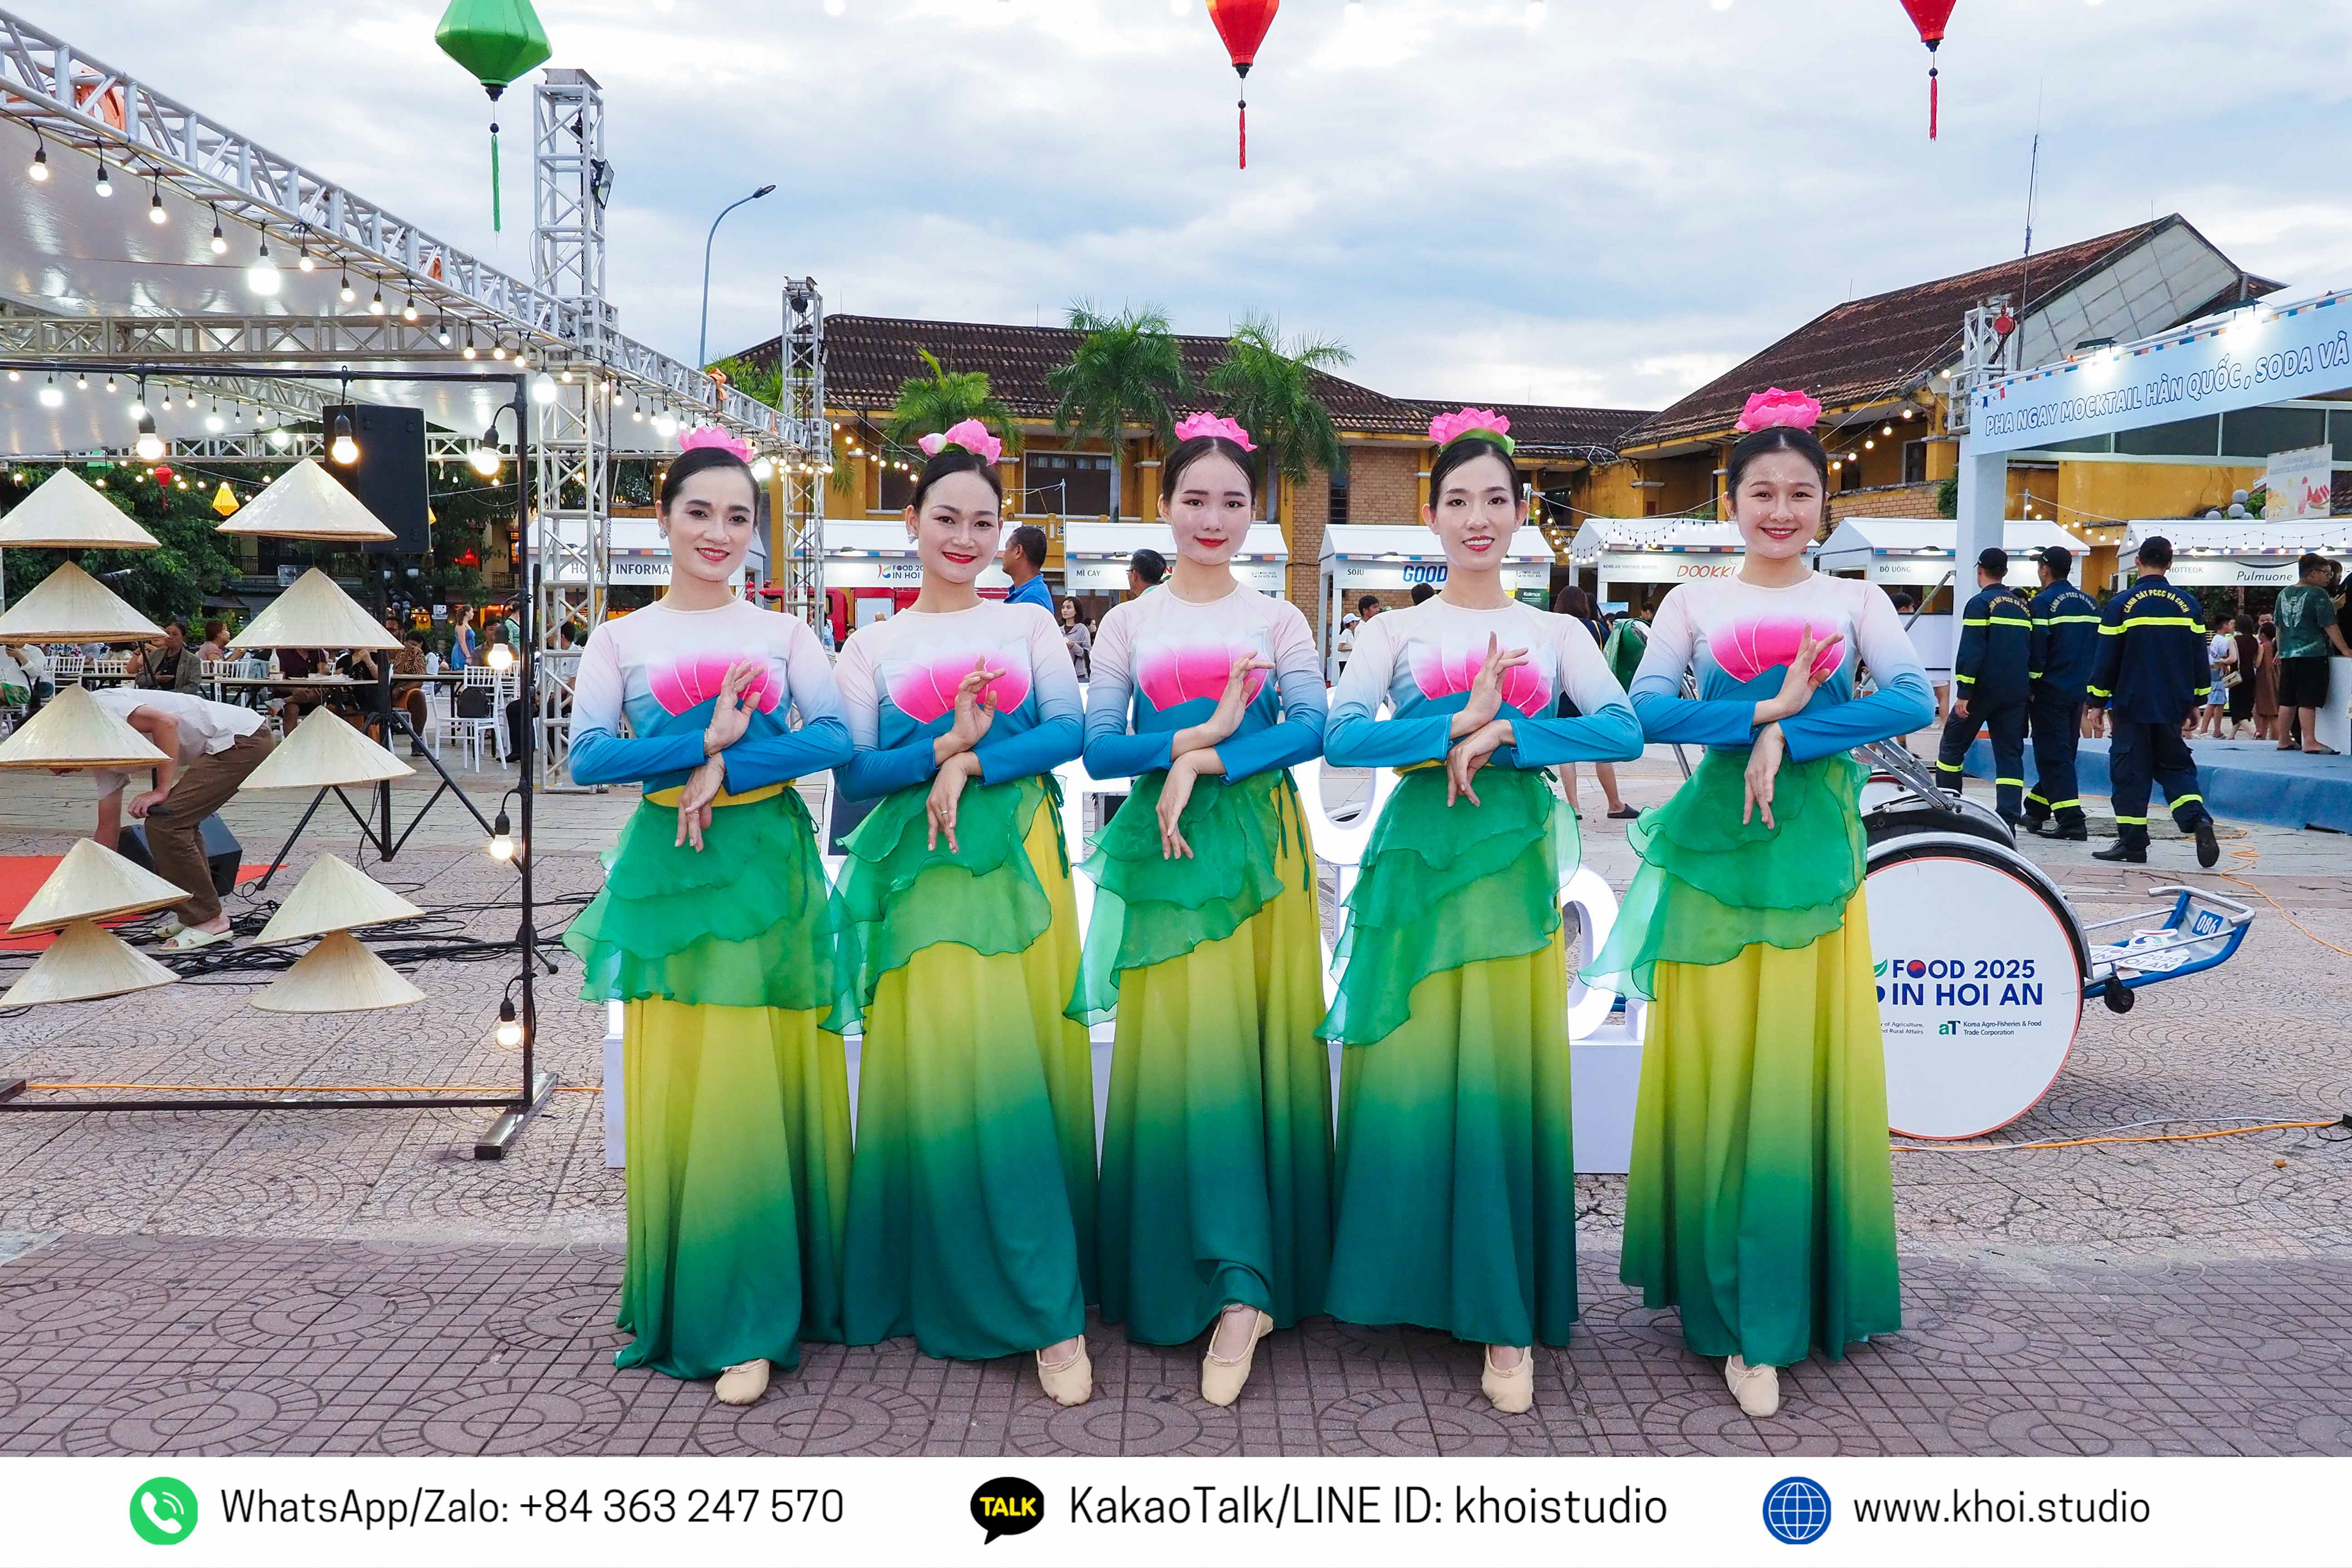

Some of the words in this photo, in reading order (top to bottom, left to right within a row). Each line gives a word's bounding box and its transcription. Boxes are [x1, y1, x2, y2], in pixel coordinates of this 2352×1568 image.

[1985, 412, 2014, 436] PHA
[2016, 403, 2058, 431] NGAY
[2060, 386, 2142, 423] MOCKTAIL
[2146, 373, 2183, 406] HÀN
[2255, 346, 2313, 383] SODA
[2318, 330, 2349, 369] VÀ
[1076, 568, 1085, 577] MÌ
[1403, 565, 1448, 582] GOOD
[1677, 565, 1736, 578] DOOKKI
[2236, 571, 2293, 581] Pulmuone
[2196, 914, 2219, 935] 086
[1893, 959, 1965, 979] FOOD
[1974, 959, 2035, 979] 2025
[1892, 983, 1924, 1006] IN
[1936, 983, 1988, 1006] HOI
[1999, 983, 2043, 1006] AN
